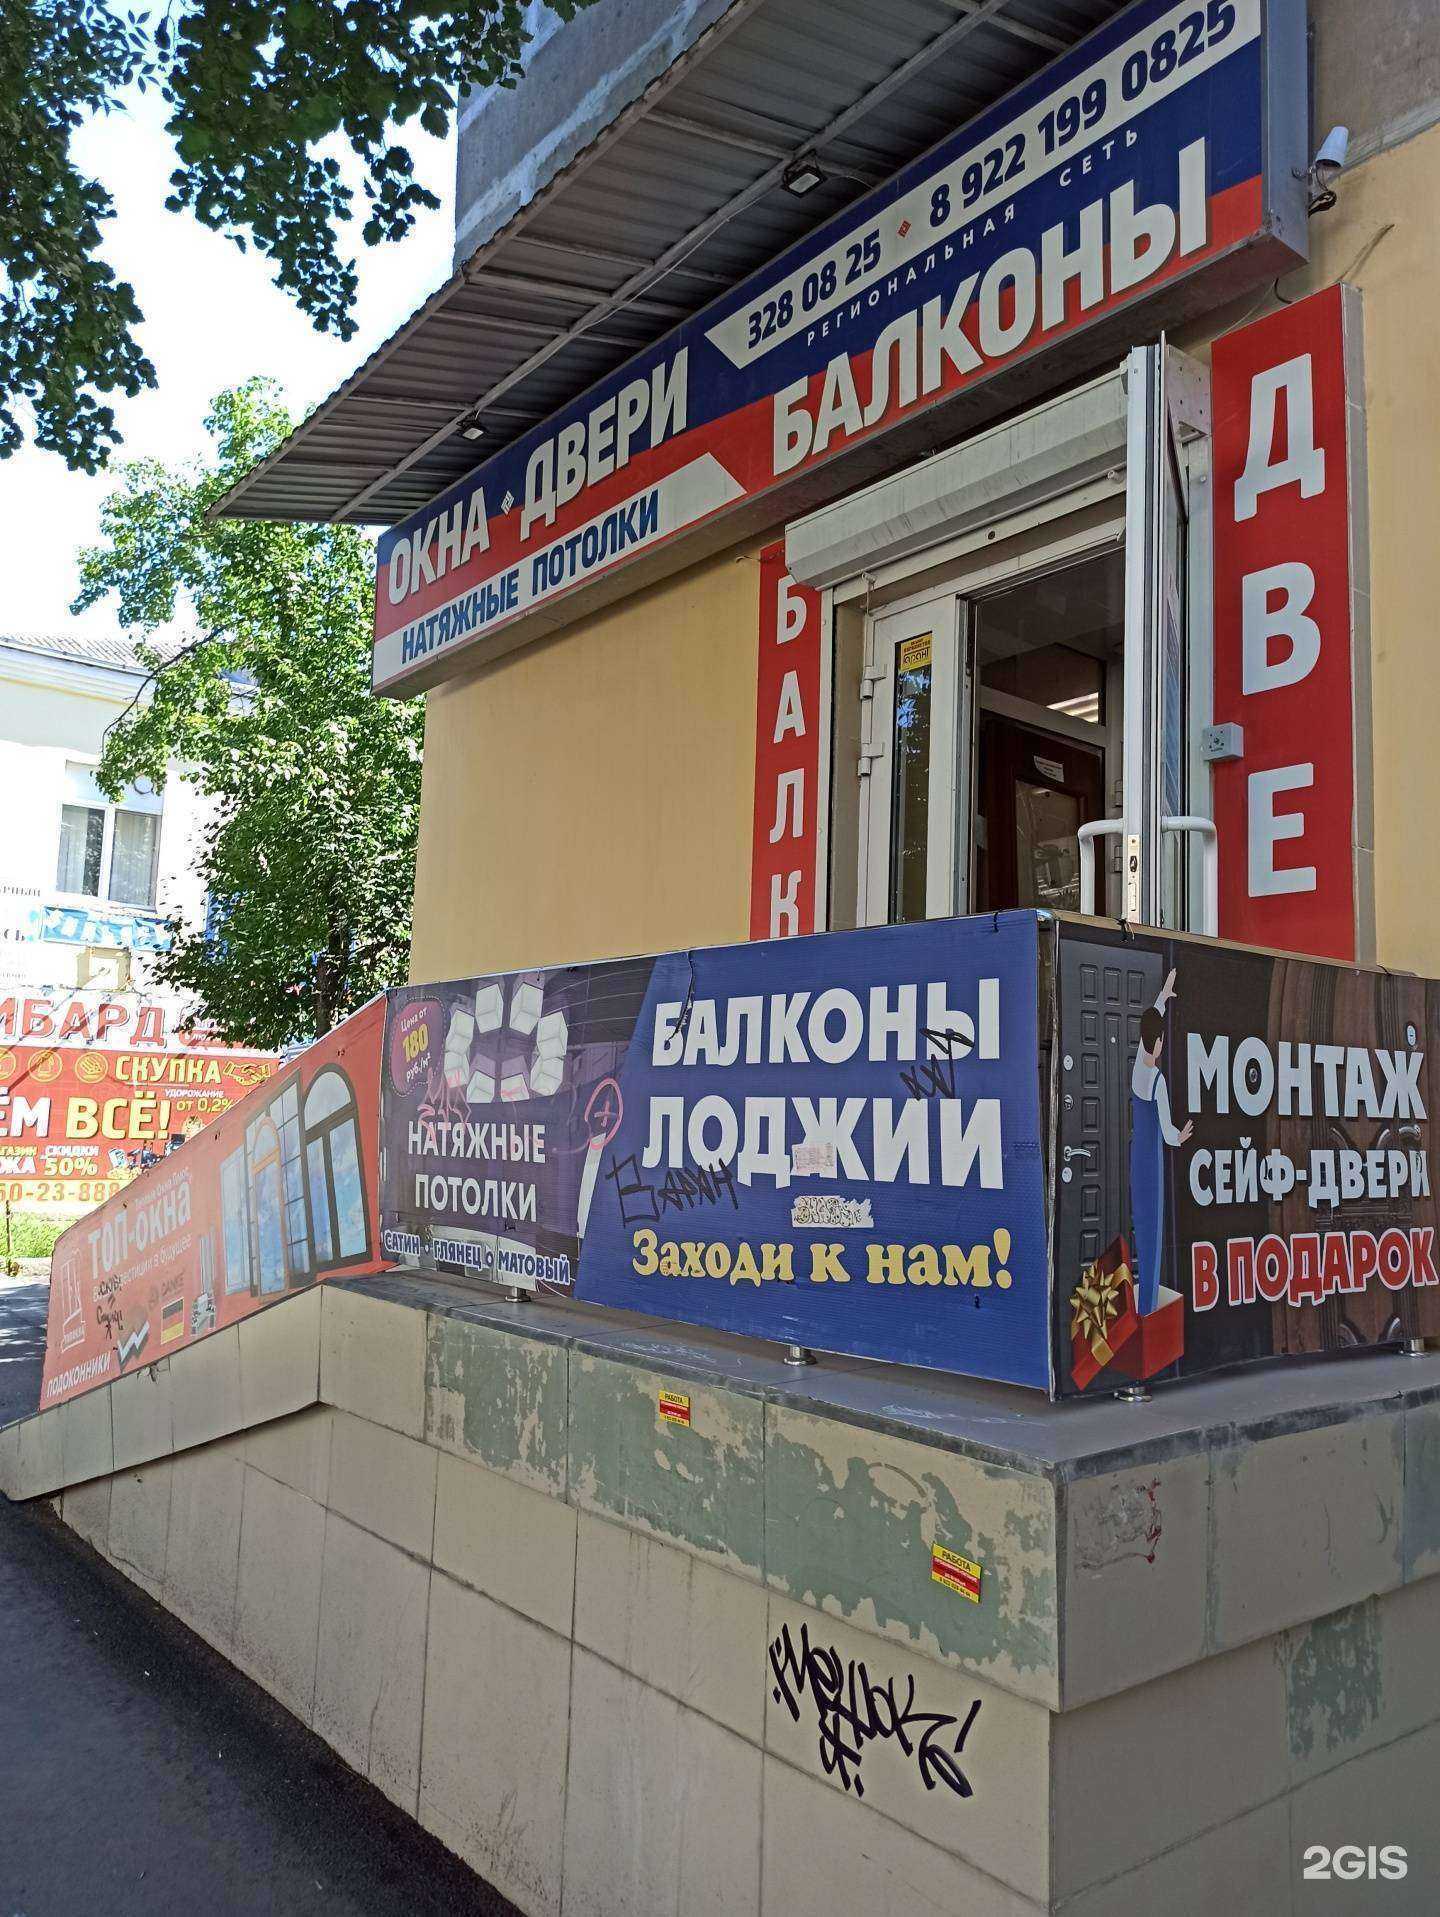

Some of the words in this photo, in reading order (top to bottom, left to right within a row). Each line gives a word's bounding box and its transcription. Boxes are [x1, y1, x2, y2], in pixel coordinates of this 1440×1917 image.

[748, 289, 795, 349] 328
[803, 259, 837, 312] 08
[846, 228, 882, 282] 25
[930, 184, 951, 228] 8
[962, 132, 1027, 211] 922
[1038, 77, 1107, 156] 199
[1122, 0, 1236, 102] 0825
[807, 202, 1015, 347] РЕГИОНАЛЬНАЯ
[1059, 129, 1139, 187] СЕТЬ
[773, 137, 1207, 476] БАЛКОНЫ
[388, 486, 490, 605] ОКНА
[520, 346, 689, 542] ДВЕРИ
[402, 569, 519, 664] НАТЯЖНЫЕ
[532, 489, 659, 597] ПОТОЛКИ
[403, 1024, 428, 1062] 180
[652, 977, 1000, 1066] БАЛКОНЫ
[115, 1055, 222, 1084] СКУПКА
[164, 1089, 224, 1098] УДОРОЖАНИЕ
[1187, 1032, 1427, 1120] МОНТАЖ
[66, 1091, 171, 1140] ВСЁ!
[408, 1121, 546, 1164] НАТЯЖНЫЕ
[642, 1095, 1004, 1189] ЛОДЖИИ
[45, 1145, 99, 1157] СКИДКИ
[1189, 1137, 1430, 1208] СЕЙФ-ДВЕРИ
[415, 1173, 537, 1222] ПОТОЛКИ
[384, 1230, 420, 1256] САТИН
[433, 1238, 482, 1271] ГЛЯНЕЦ
[498, 1251, 570, 1285] МАТОВЫЙ
[632, 1228, 794, 1287] Заходи
[810, 1242, 850, 1282] к
[865, 1227, 1012, 1289] нам!
[1191, 1241, 1219, 1313] В
[1227, 1226, 1439, 1308] ПОДАРОК
[47, 1352, 111, 1397] ПОДОКОННИКИ
